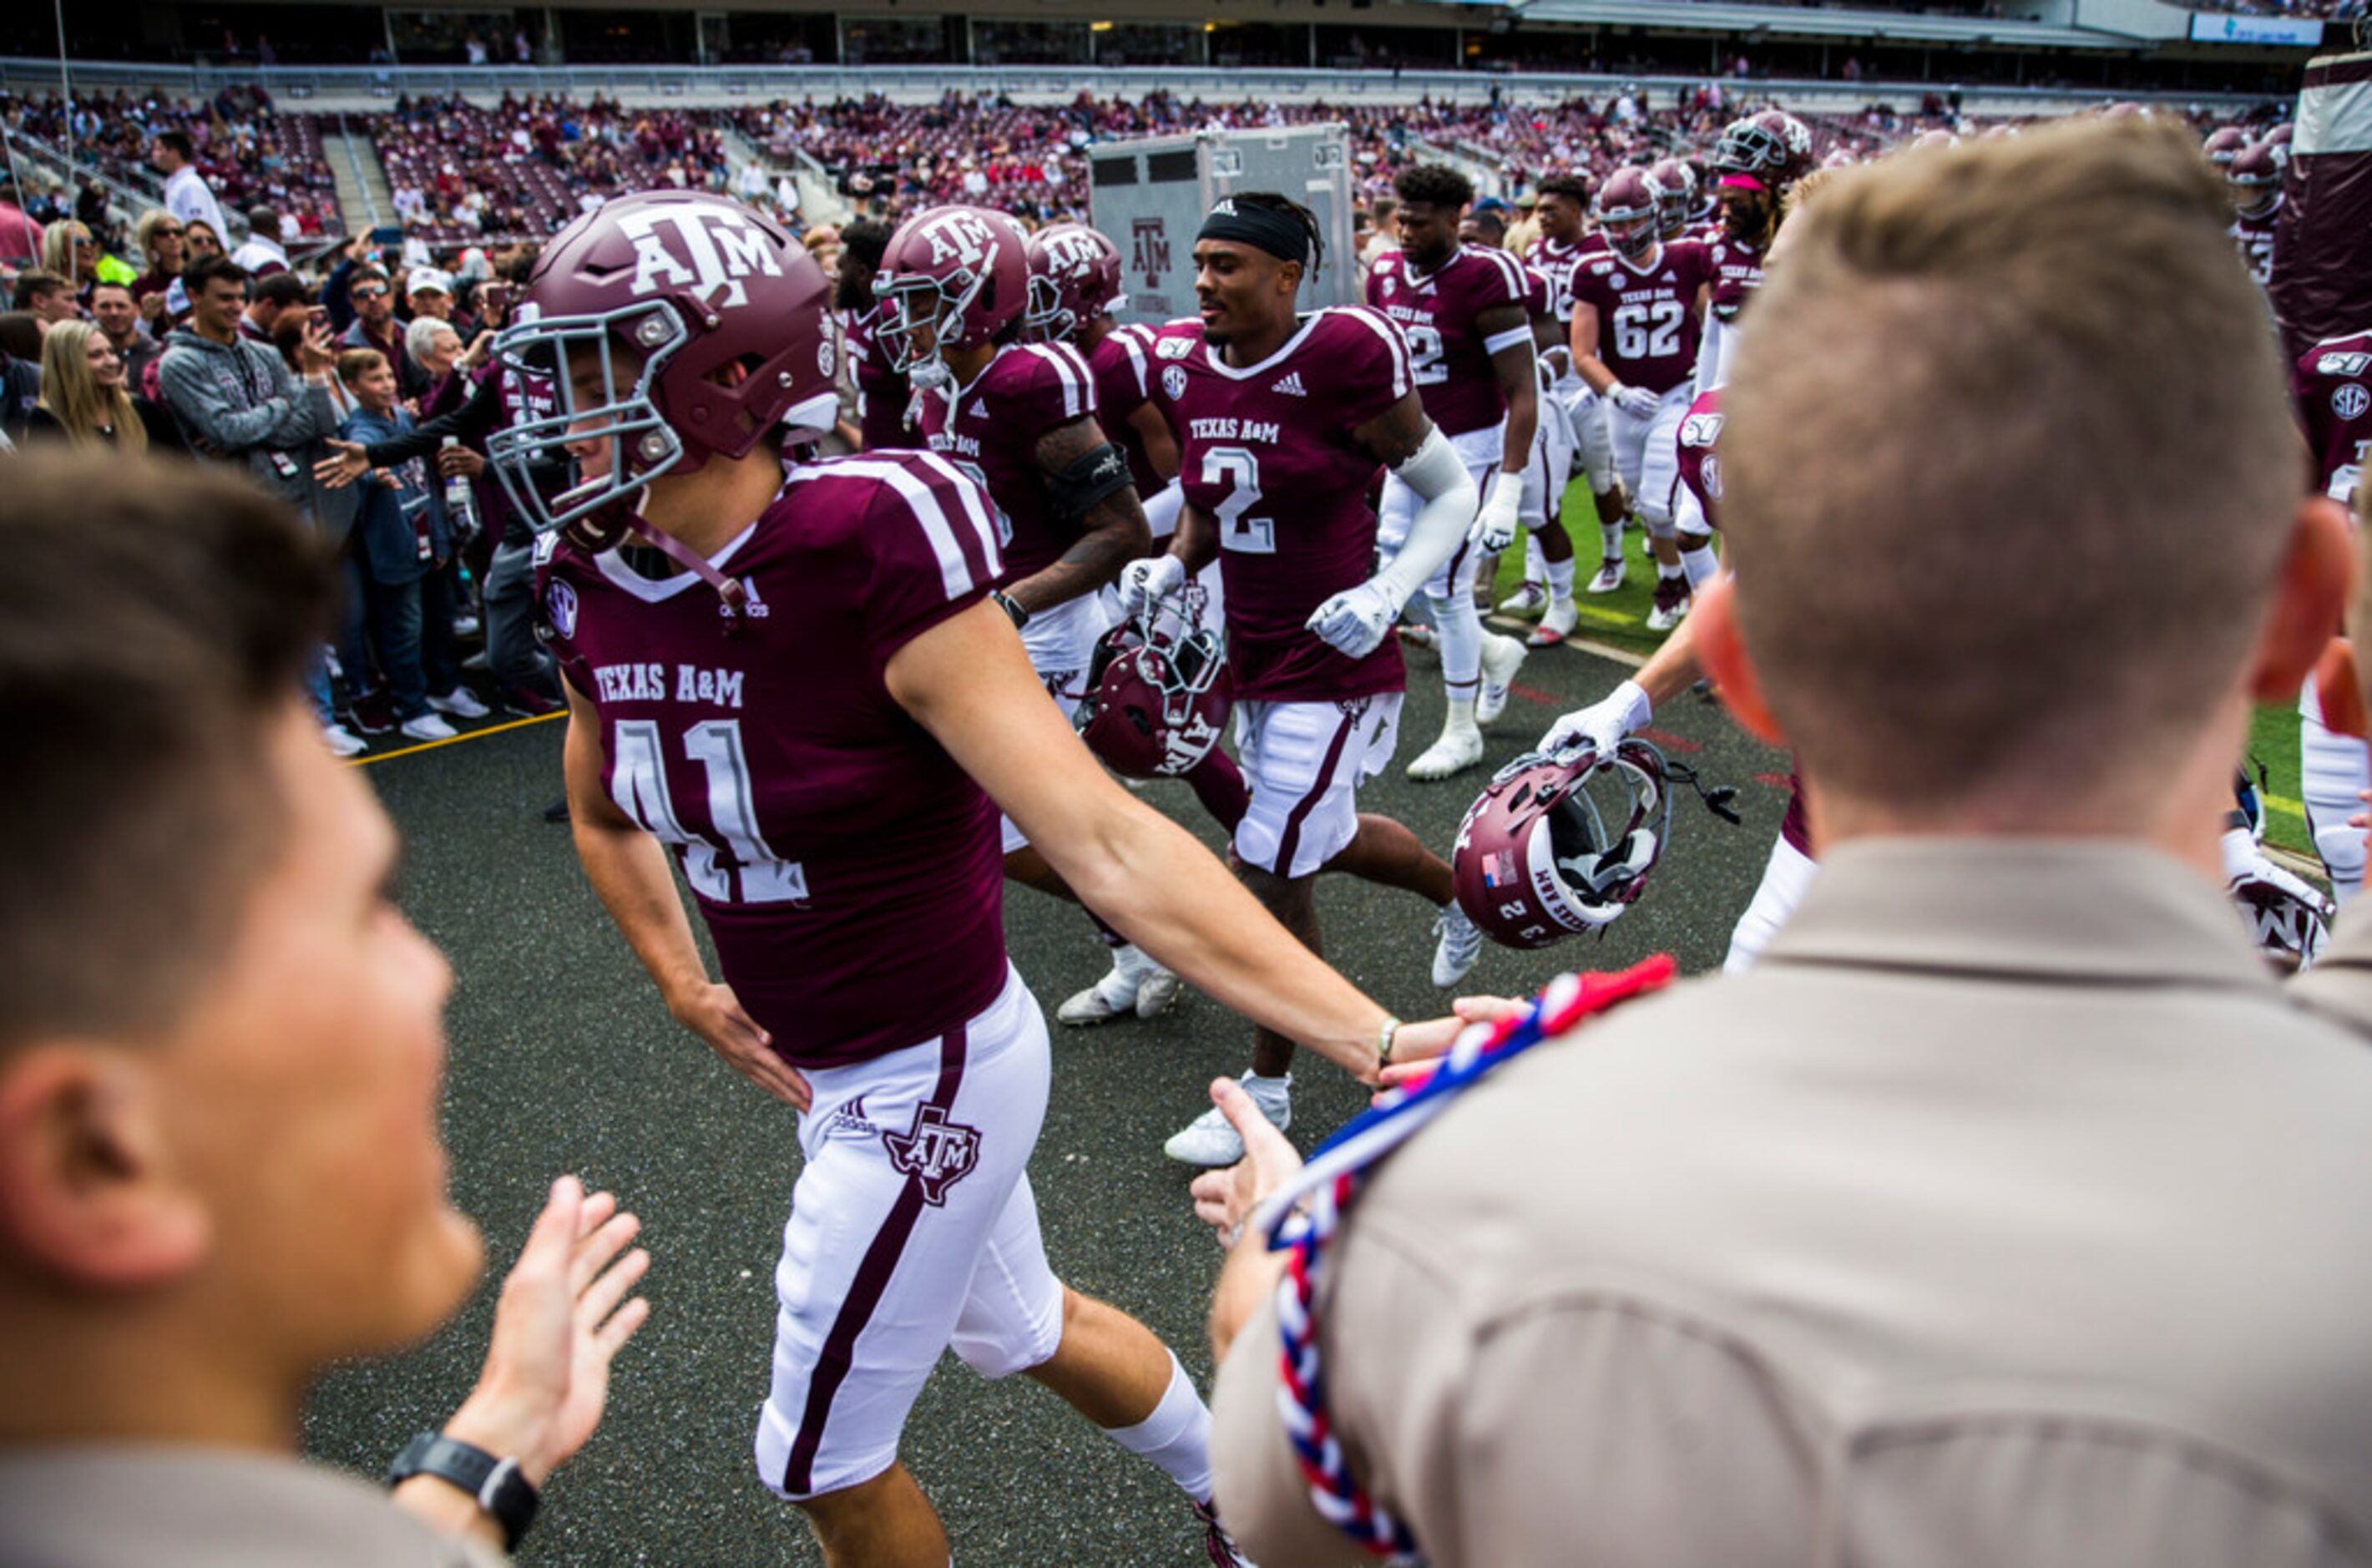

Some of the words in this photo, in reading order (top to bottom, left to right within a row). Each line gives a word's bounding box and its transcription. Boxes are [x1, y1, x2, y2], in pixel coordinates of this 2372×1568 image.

[1613, 301, 1684, 359] 62
[1190, 418, 1238, 439] TEXAS
[1241, 420, 1280, 443] A&M
[1201, 447, 1276, 553] 2
[594, 663, 665, 702] TEXAS
[676, 665, 744, 708] A&M
[611, 720, 809, 903] 41
